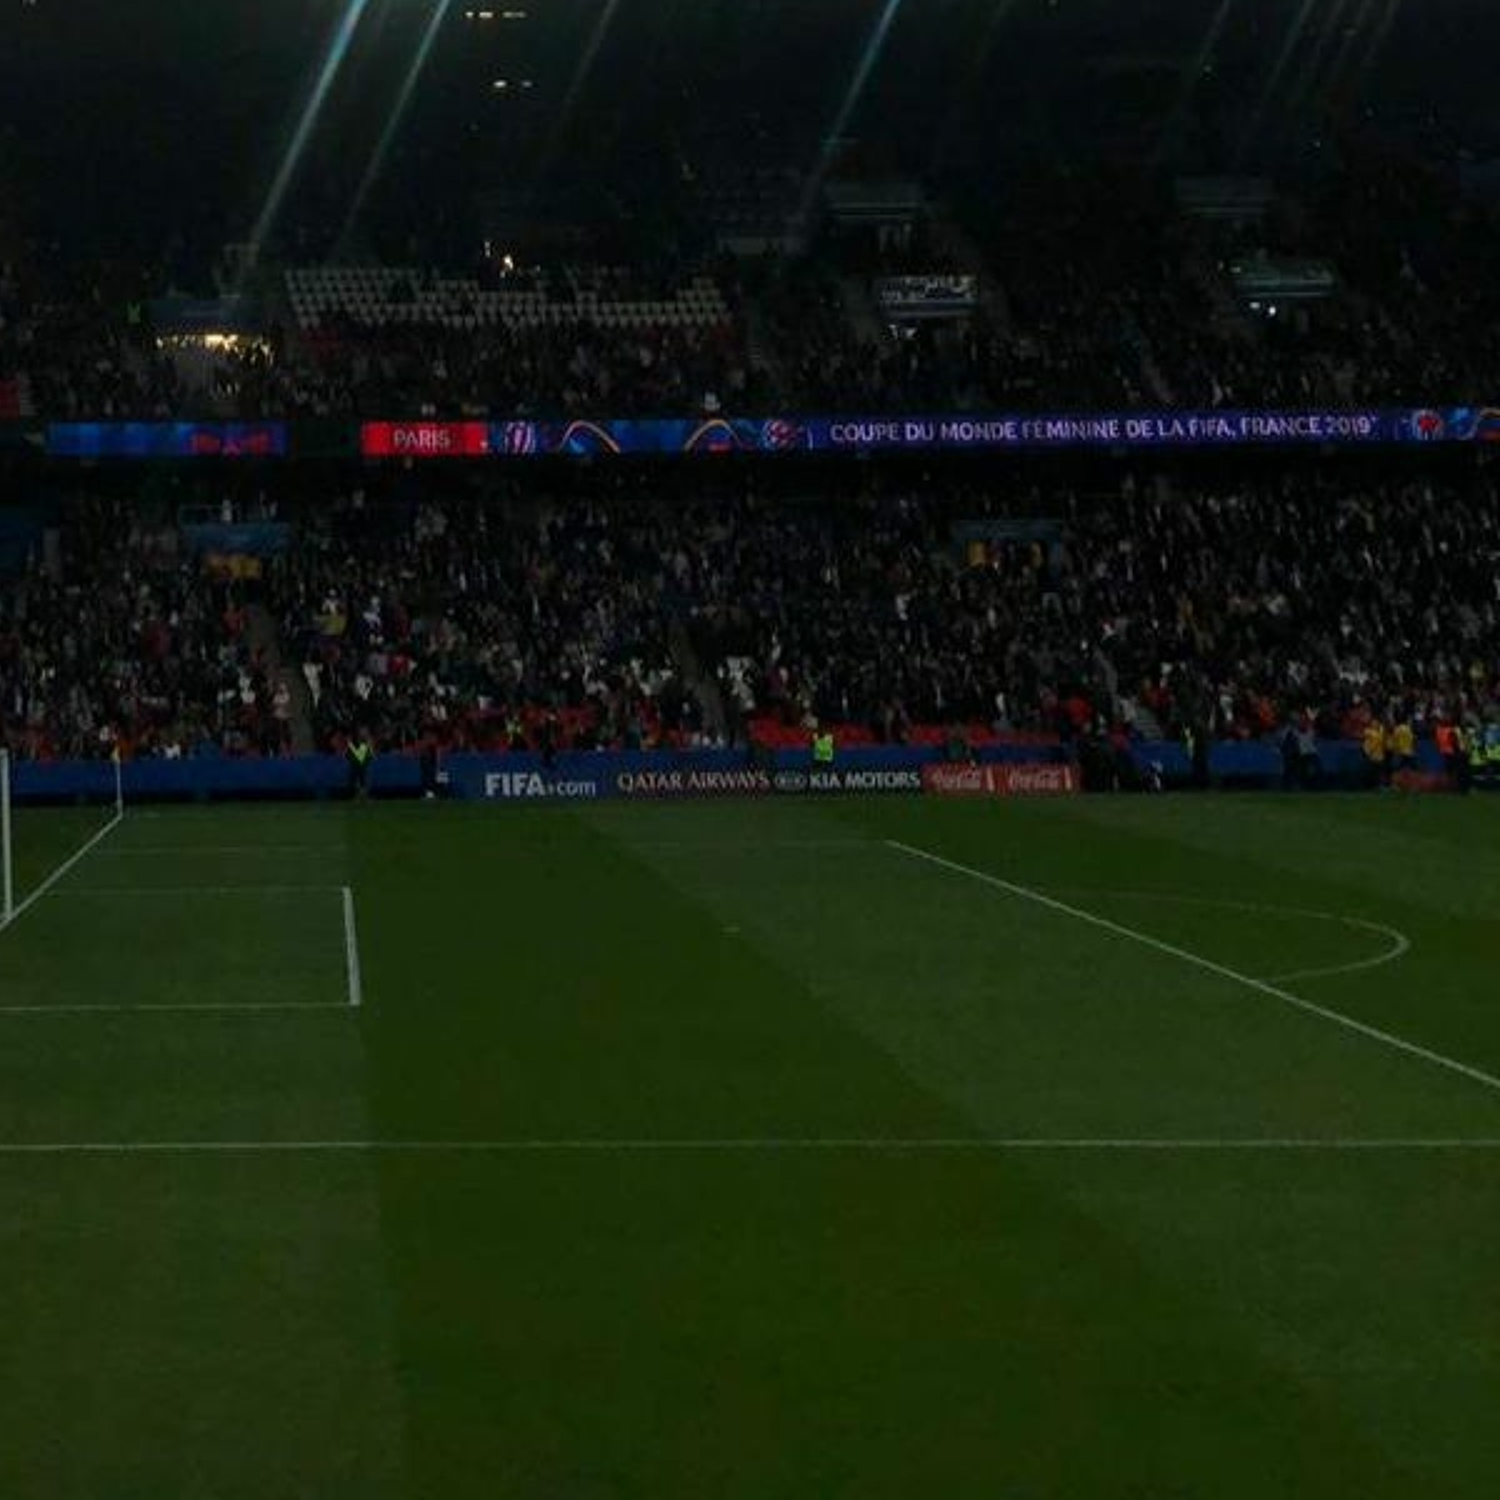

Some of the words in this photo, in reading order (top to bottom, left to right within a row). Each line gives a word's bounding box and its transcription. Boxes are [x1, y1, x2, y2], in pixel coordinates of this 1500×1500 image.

[393, 429, 450, 450] PARIS
[829, 422, 900, 441] COUPE
[904, 422, 934, 441] DU
[939, 421, 1018, 441] MONDE
[1125, 418, 1155, 438] DE
[1157, 418, 1184, 437] LA
[1240, 416, 1323, 437] FRANCE
[616, 771, 682, 794] QATAR
[687, 768, 771, 792] AIRWAYS
[809, 770, 842, 790] KIA
[845, 770, 921, 790] MOTORS
